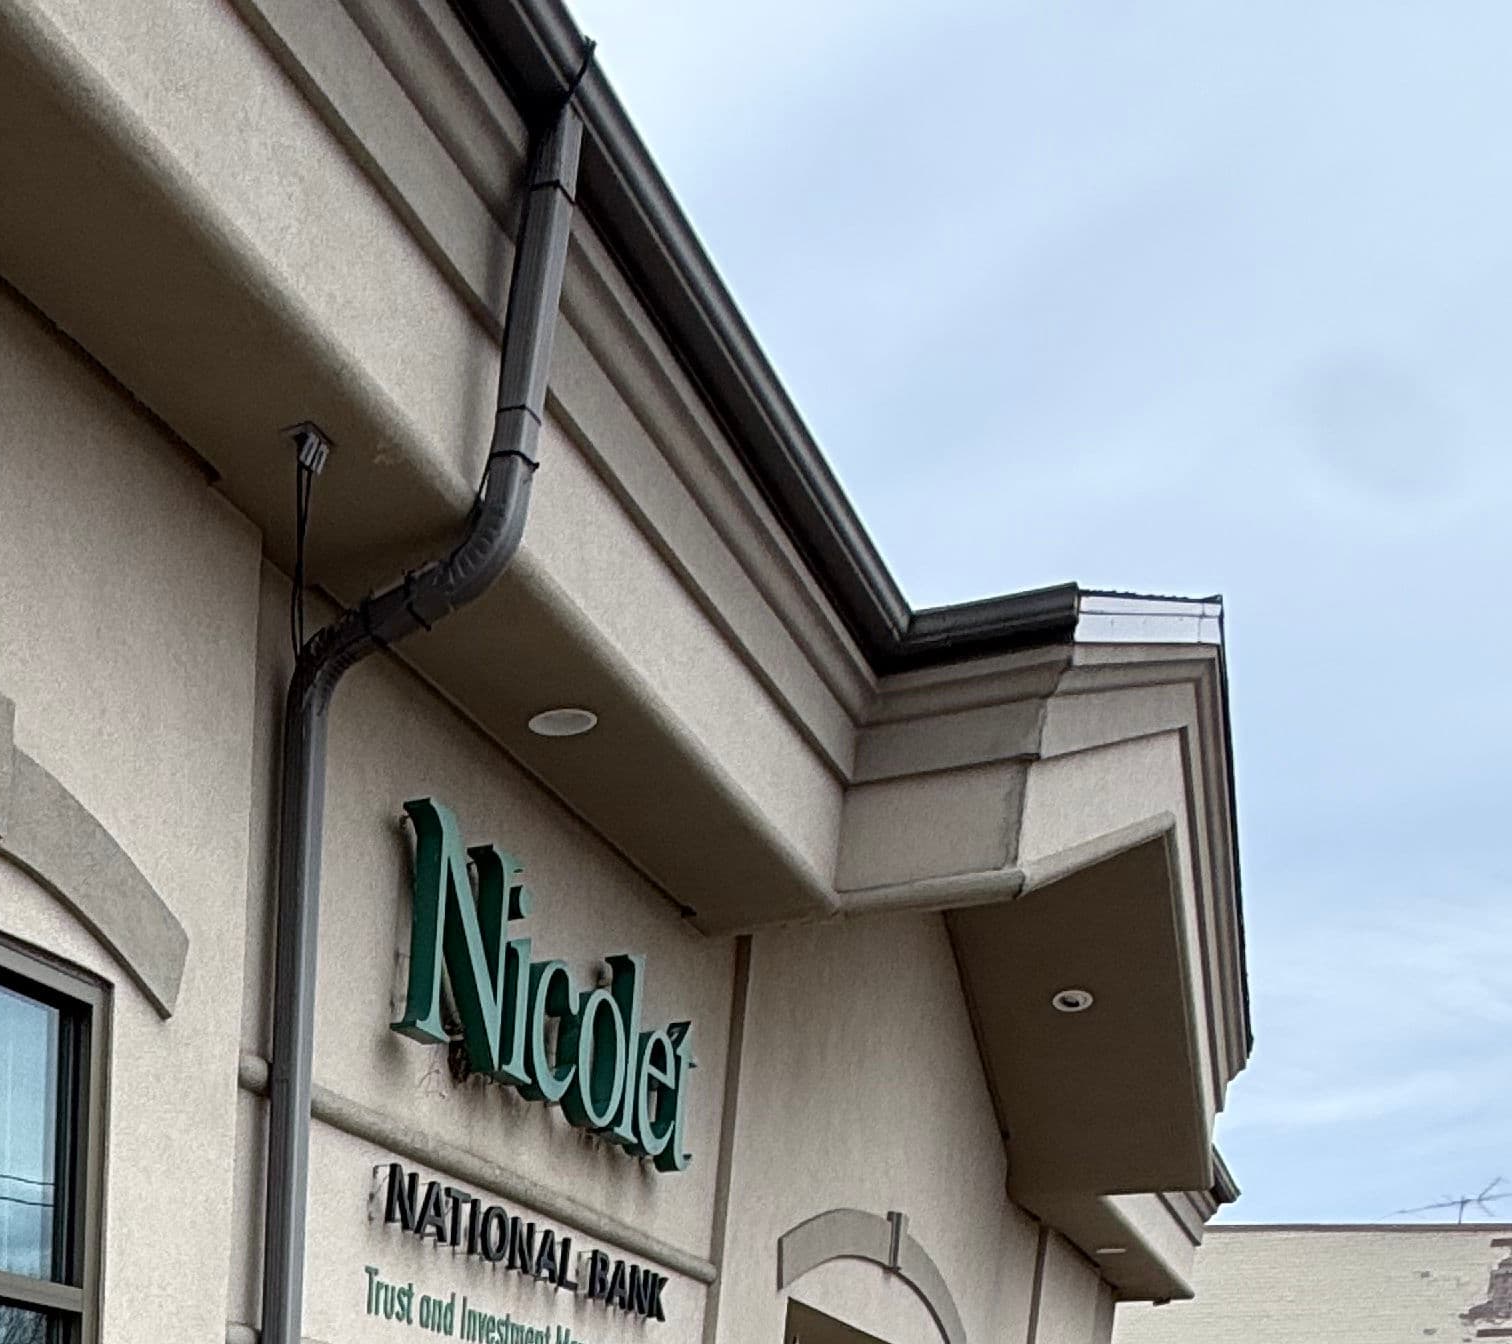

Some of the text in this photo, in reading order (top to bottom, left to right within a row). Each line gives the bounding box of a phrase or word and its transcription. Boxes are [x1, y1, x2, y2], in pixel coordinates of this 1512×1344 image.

[391, 797, 697, 1172] Nicolet
[364, 1265, 415, 1326] Trust
[418, 1290, 457, 1337] and
[384, 1162, 670, 1323] NATIONAL BANK
